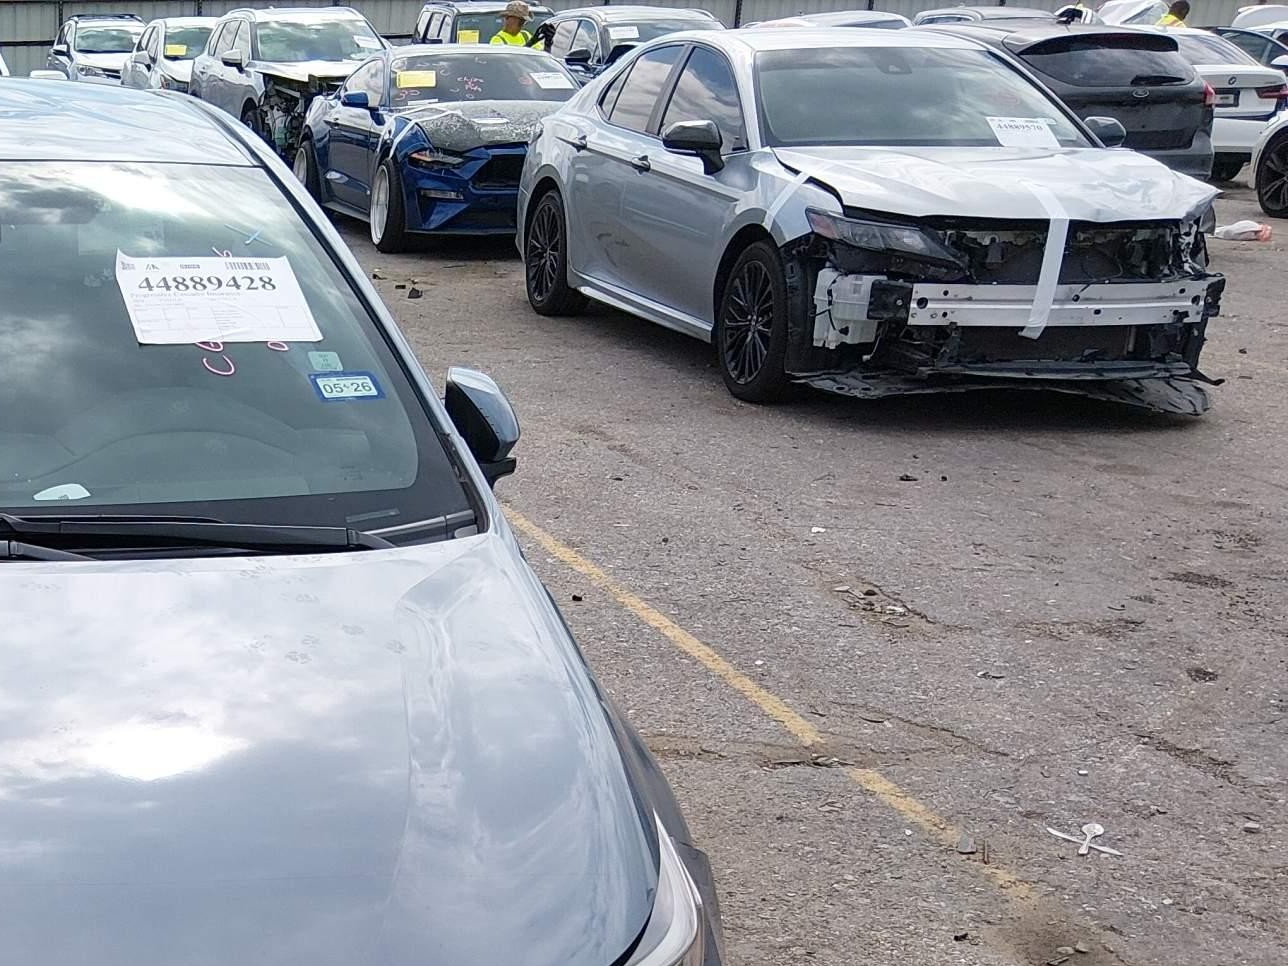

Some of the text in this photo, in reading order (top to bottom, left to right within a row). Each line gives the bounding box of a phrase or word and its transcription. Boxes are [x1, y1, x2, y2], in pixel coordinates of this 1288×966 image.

[138, 275, 277, 291] 44889428
[323, 382, 372, 394] 05 26
